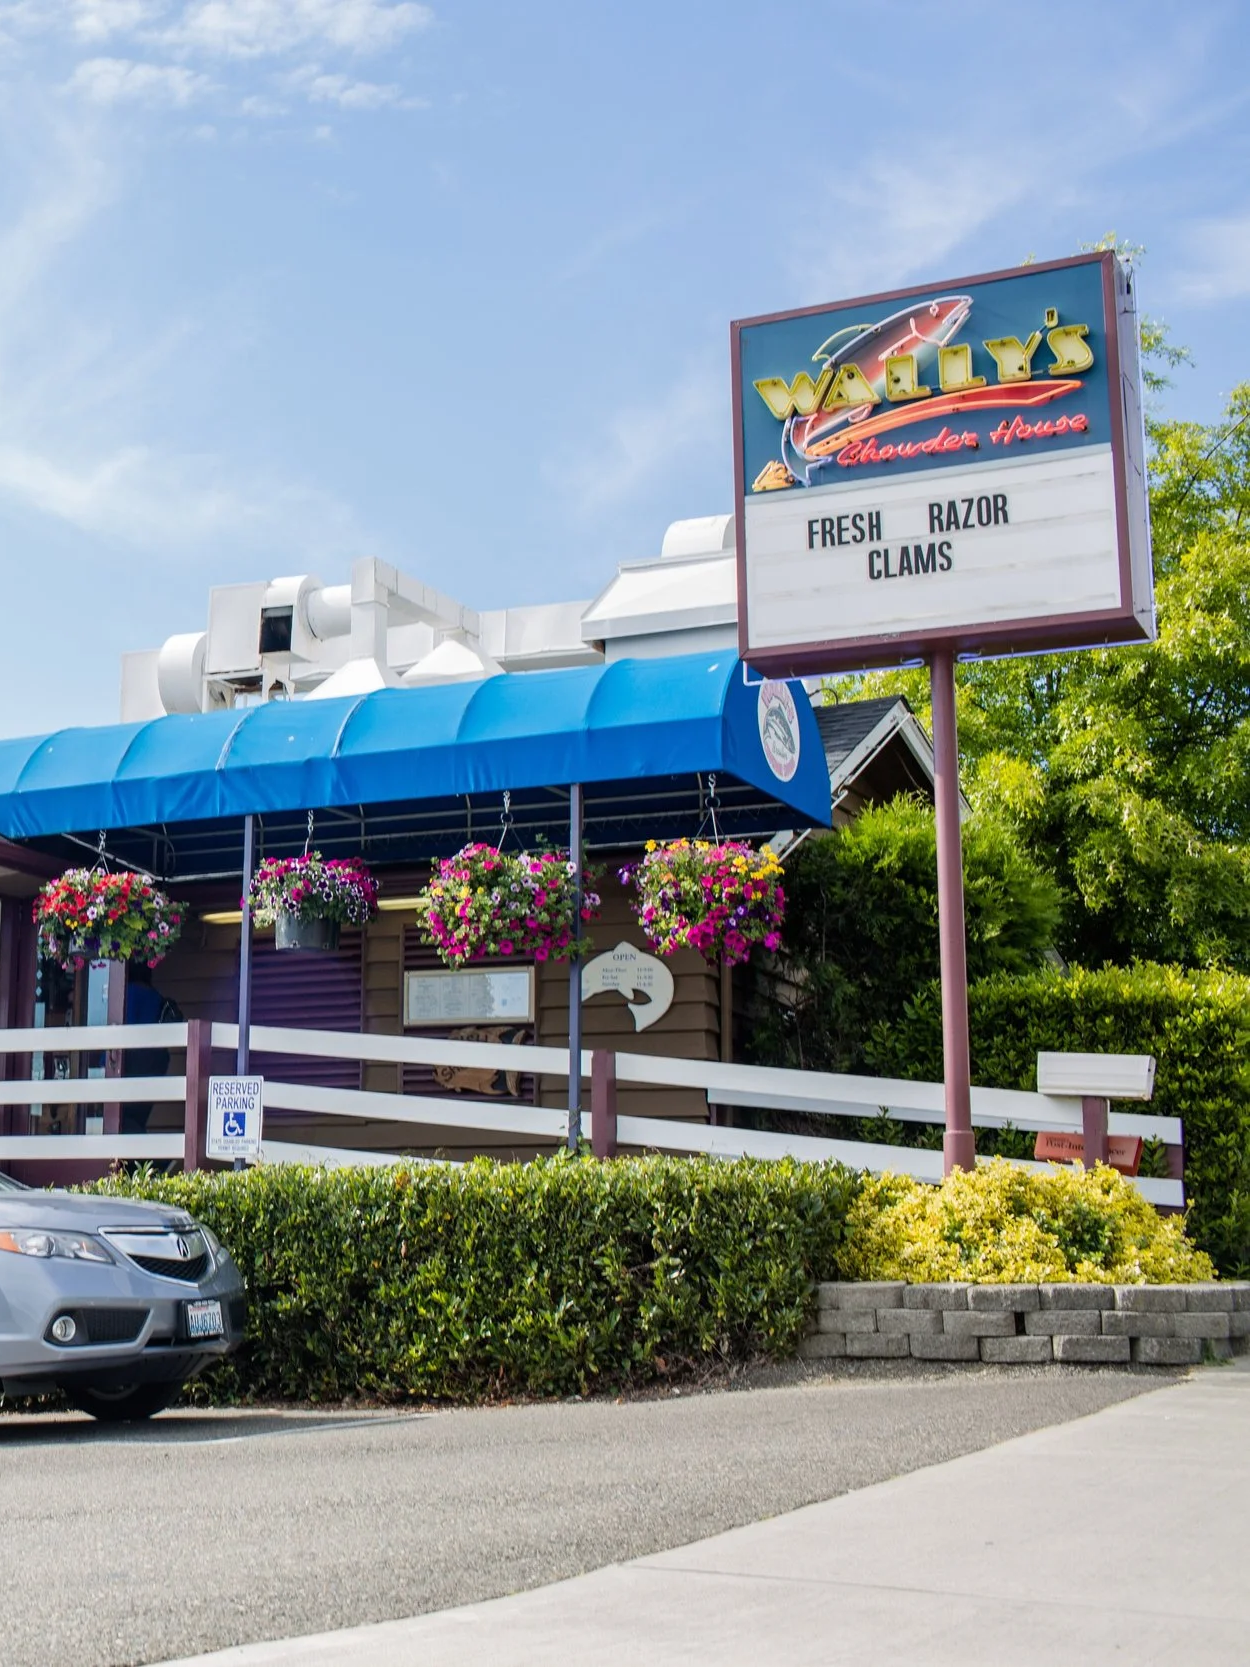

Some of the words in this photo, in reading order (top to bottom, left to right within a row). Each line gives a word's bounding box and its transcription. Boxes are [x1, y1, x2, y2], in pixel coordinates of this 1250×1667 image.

[753, 307, 1094, 419] WALLY'S
[837, 427, 979, 467] Chowder
[990, 413, 1089, 445] House
[807, 510, 882, 549] FRESH
[928, 493, 1009, 534] RAZOR
[868, 541, 952, 580] CLAMS
[612, 952, 637, 961] OPEN
[213, 1081, 259, 1096] RESERVED
[215, 1096, 255, 1110] PARKING
